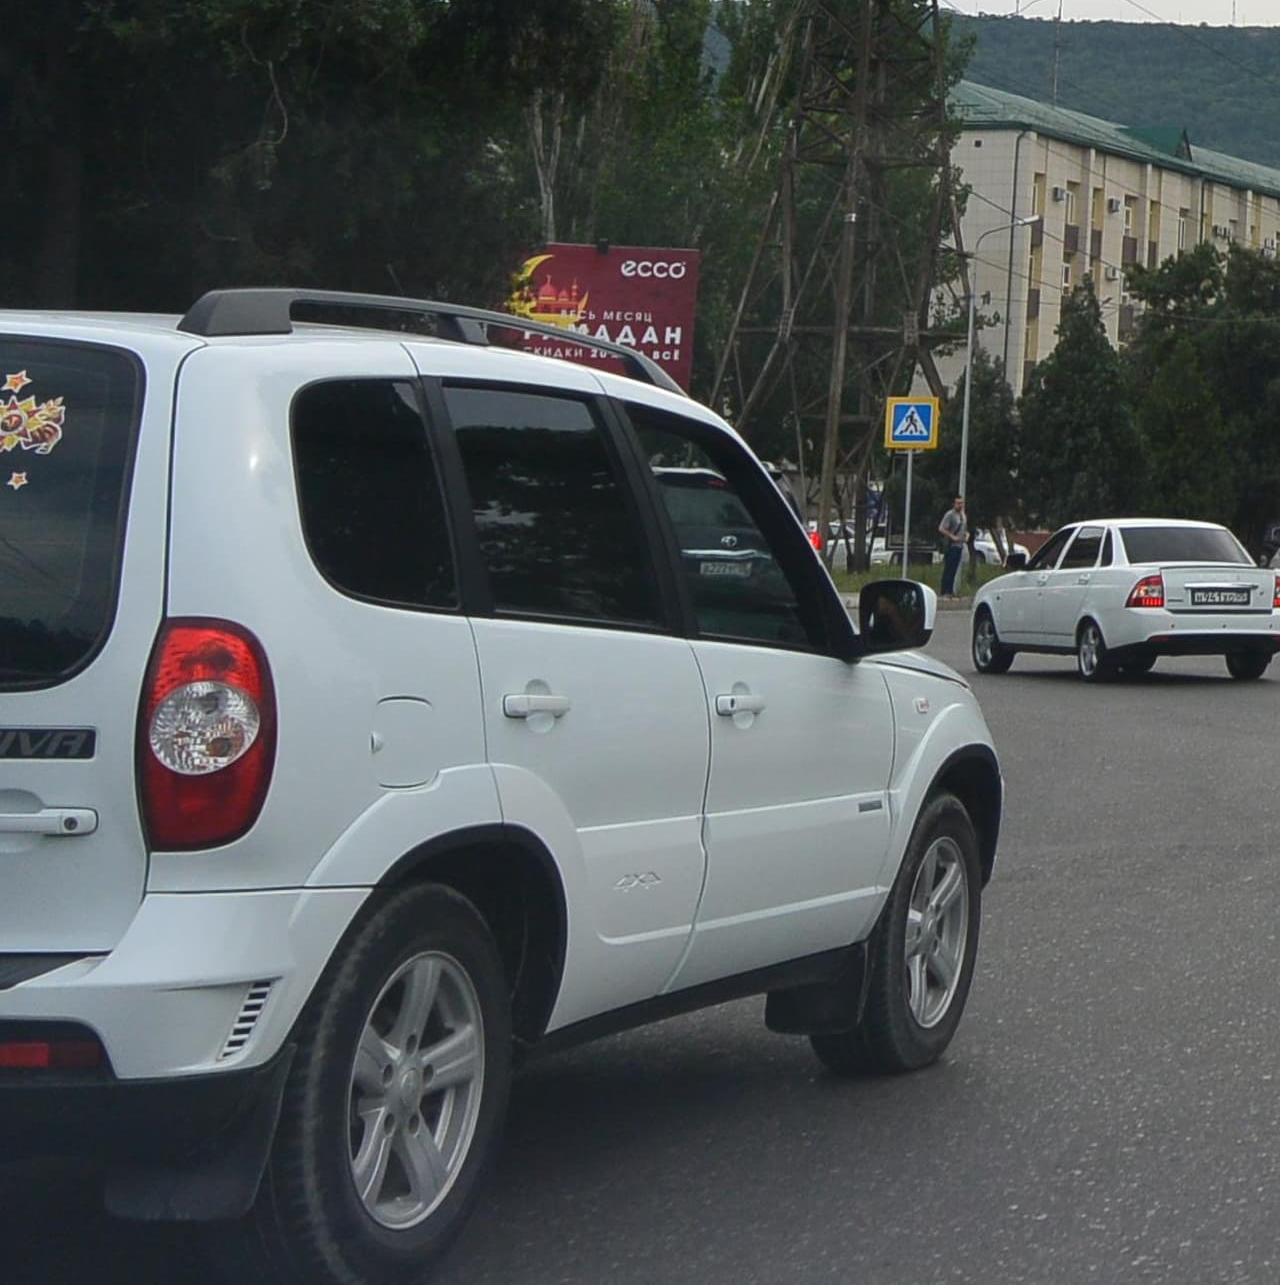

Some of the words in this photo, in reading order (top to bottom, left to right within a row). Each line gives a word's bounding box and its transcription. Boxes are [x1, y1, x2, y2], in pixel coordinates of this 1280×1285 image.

[620, 260, 686, 279] ecco
[560, 309, 596, 321] ВЕСЬ
[603, 311, 653, 323] МЕСЯЦ
[524, 322, 683, 346] МАДАН
[0, 730, 89, 756] IVA
